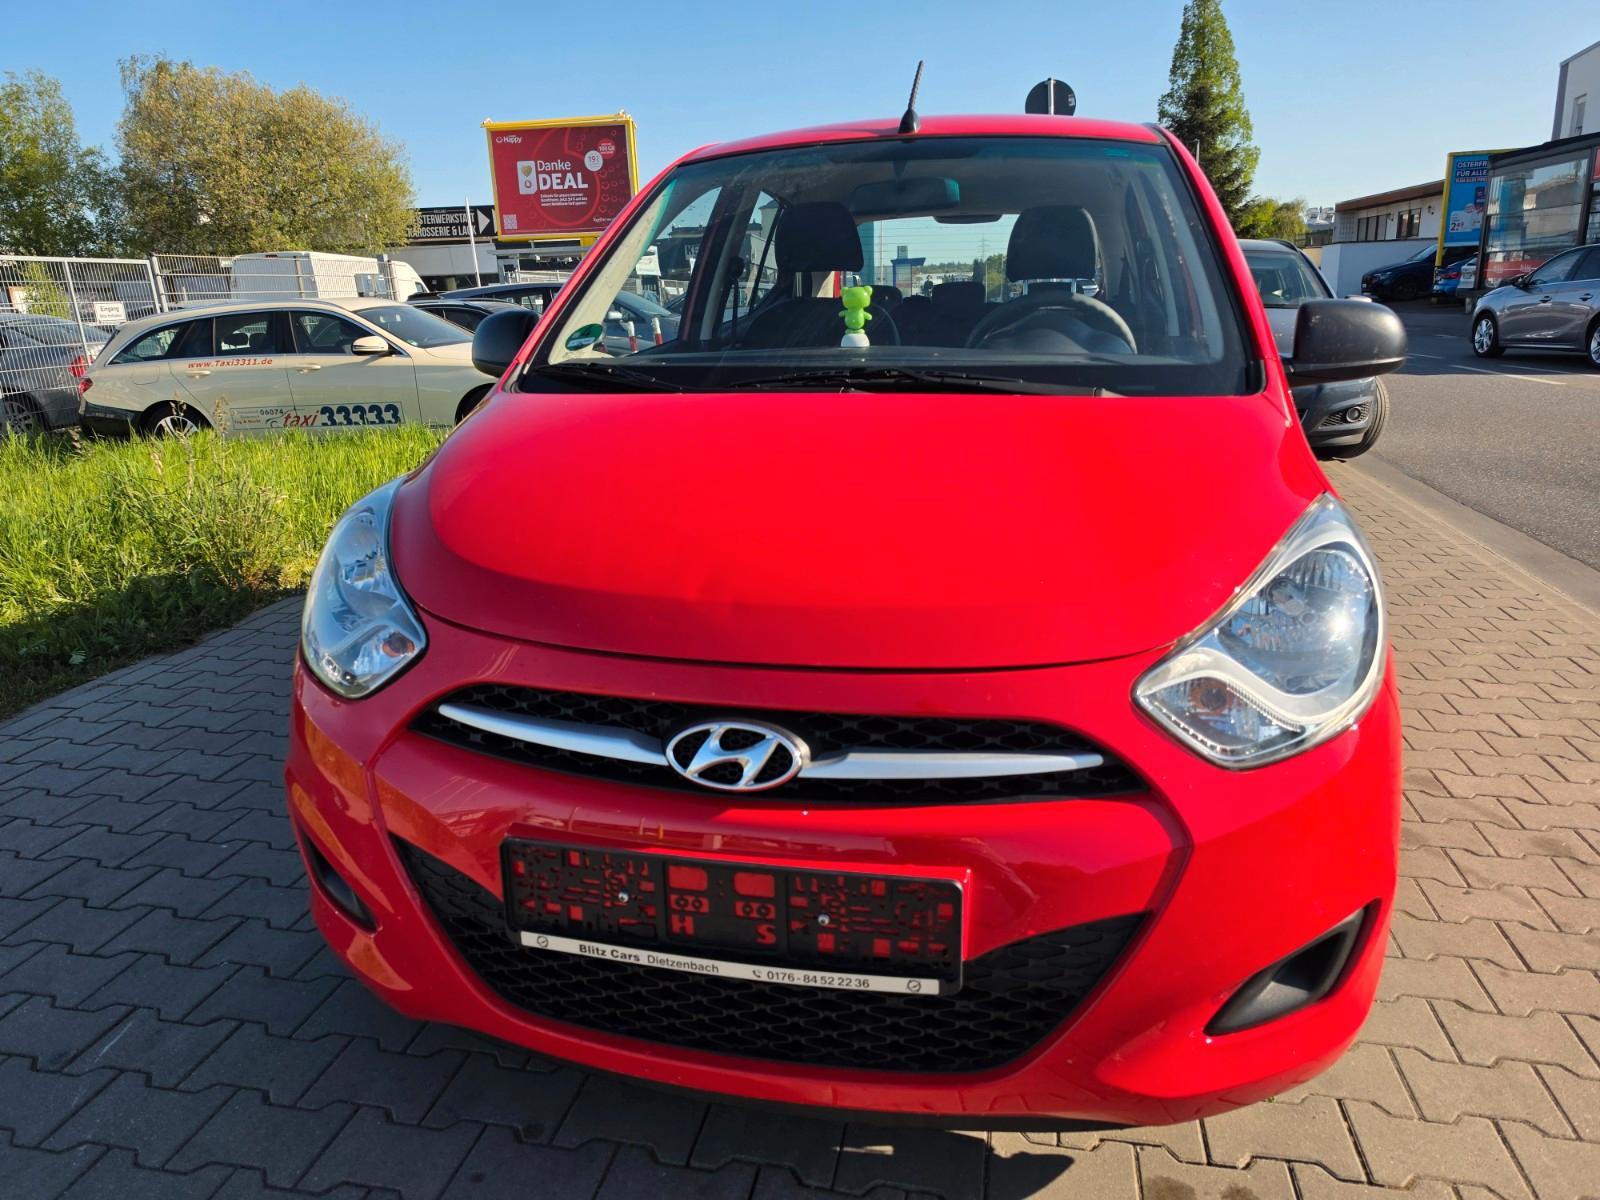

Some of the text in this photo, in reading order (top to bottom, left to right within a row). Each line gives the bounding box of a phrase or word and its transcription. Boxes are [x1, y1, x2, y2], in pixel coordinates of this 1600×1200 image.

[503, 135, 522, 144] Happy
[537, 160, 571, 171] Danke
[538, 172, 589, 190] DEAL
[188, 357, 273, 369] www.Taxi3311.de
[259, 408, 284, 416] 06074
[282, 410, 319, 428] taxi
[320, 403, 401, 427] 33333
[579, 943, 607, 957] Blitz
[610, 949, 641, 962] Cars
[647, 954, 720, 974] Dietzenbach
